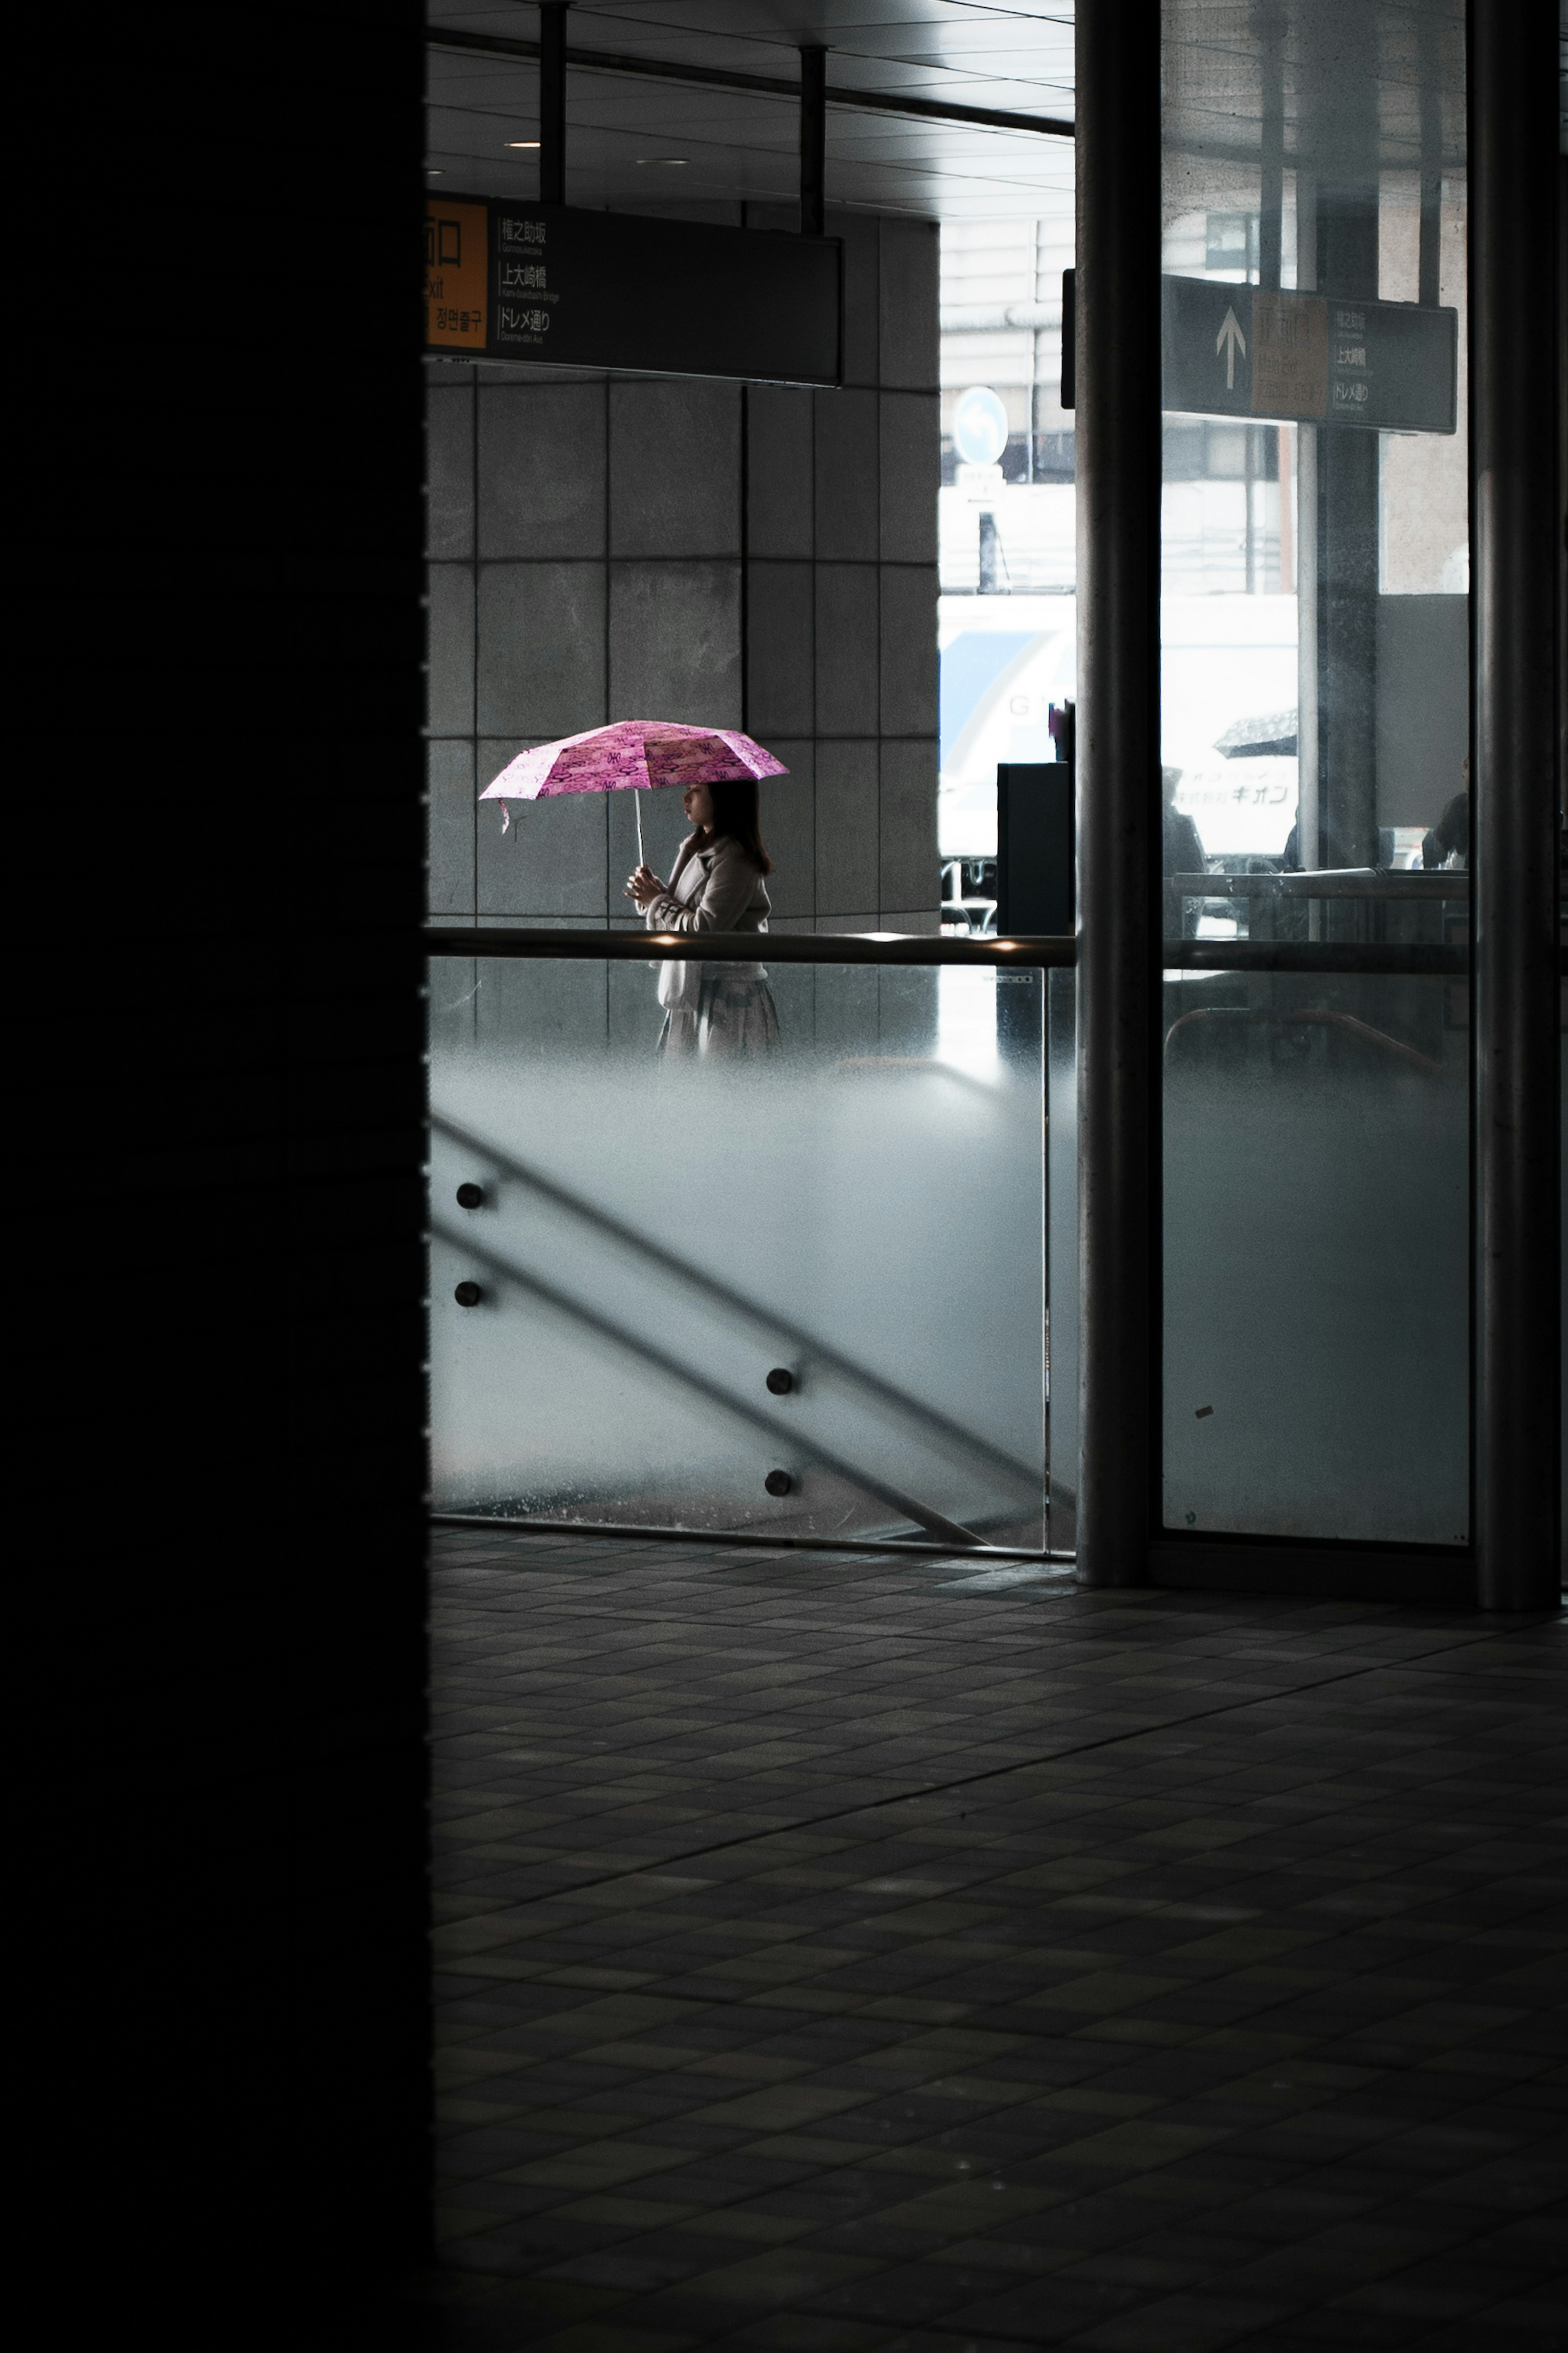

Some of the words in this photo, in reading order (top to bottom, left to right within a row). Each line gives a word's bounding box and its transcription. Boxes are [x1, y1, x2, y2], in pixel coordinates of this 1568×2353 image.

[502, 218, 546, 243] 権之助坂
[502, 263, 546, 288] 上大崎橋
[501, 306, 550, 331] ドレメ通り
